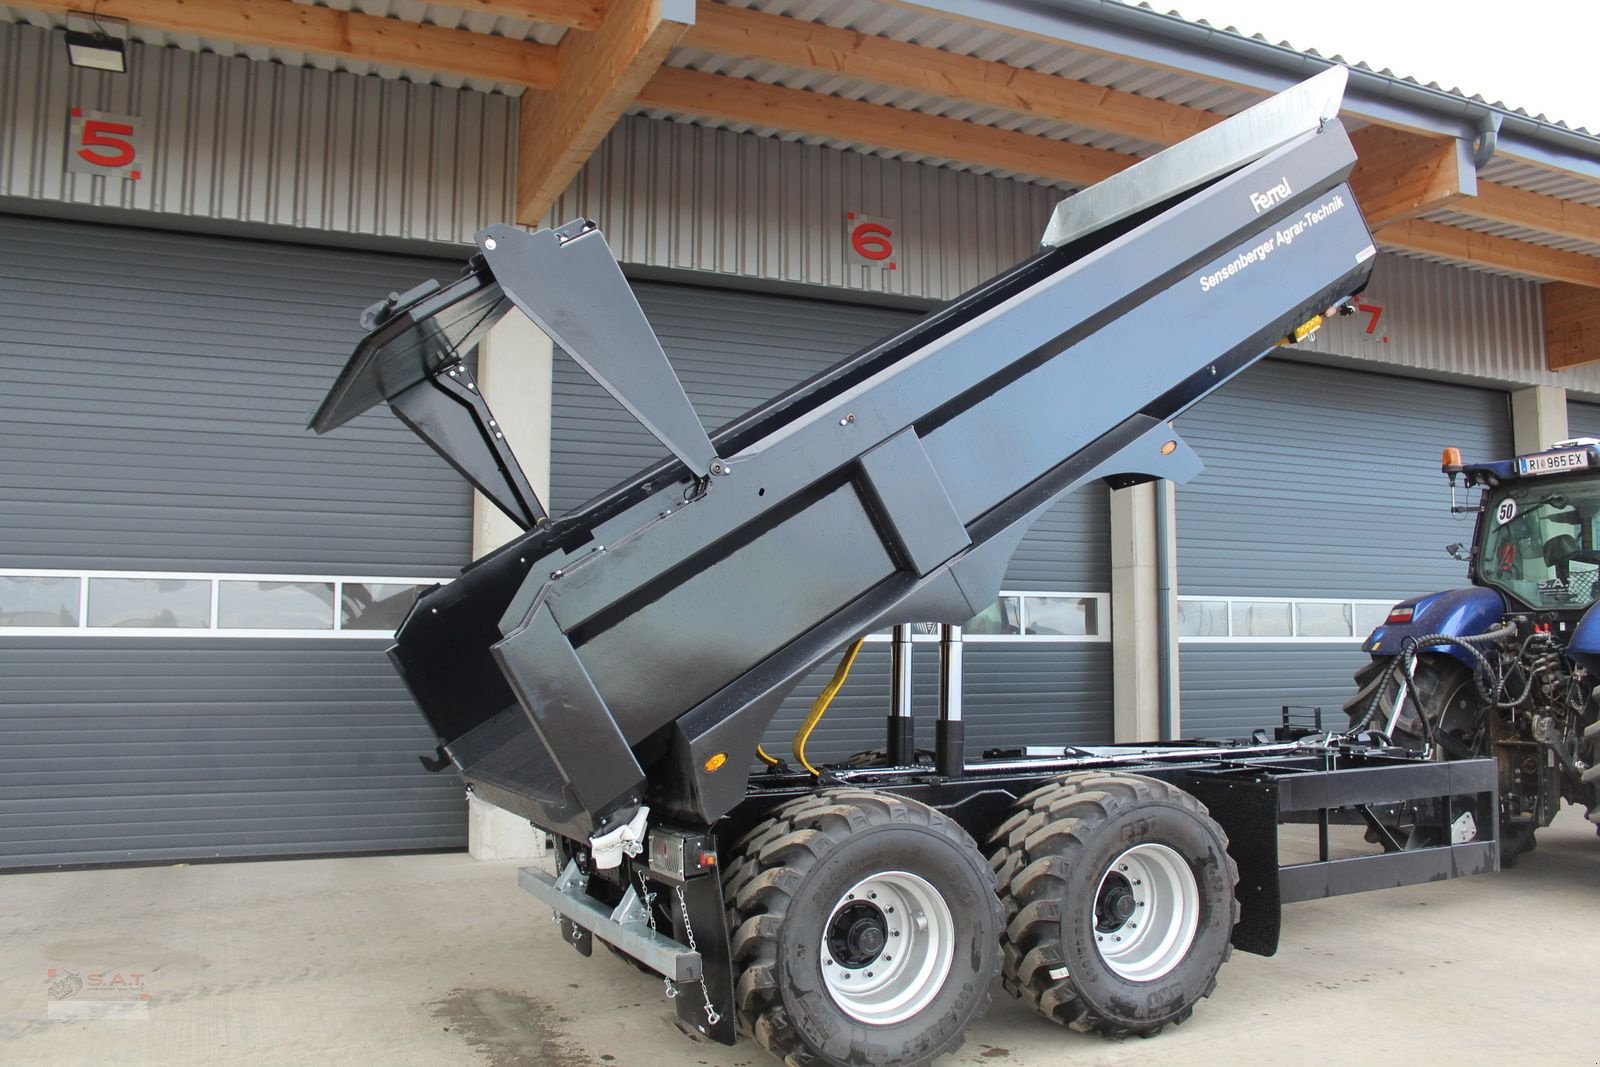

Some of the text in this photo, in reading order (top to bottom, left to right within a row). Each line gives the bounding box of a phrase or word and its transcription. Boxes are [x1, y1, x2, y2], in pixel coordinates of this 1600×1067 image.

[77, 119, 136, 168] 5
[1250, 177, 1292, 213] Ferrel
[851, 223, 893, 261] 6
[1199, 195, 1344, 291] Sensenberger Agrar-Technik
[1358, 303, 1383, 334] 7
[1529, 459, 1540, 470] RI
[1499, 503, 1513, 520] 50
